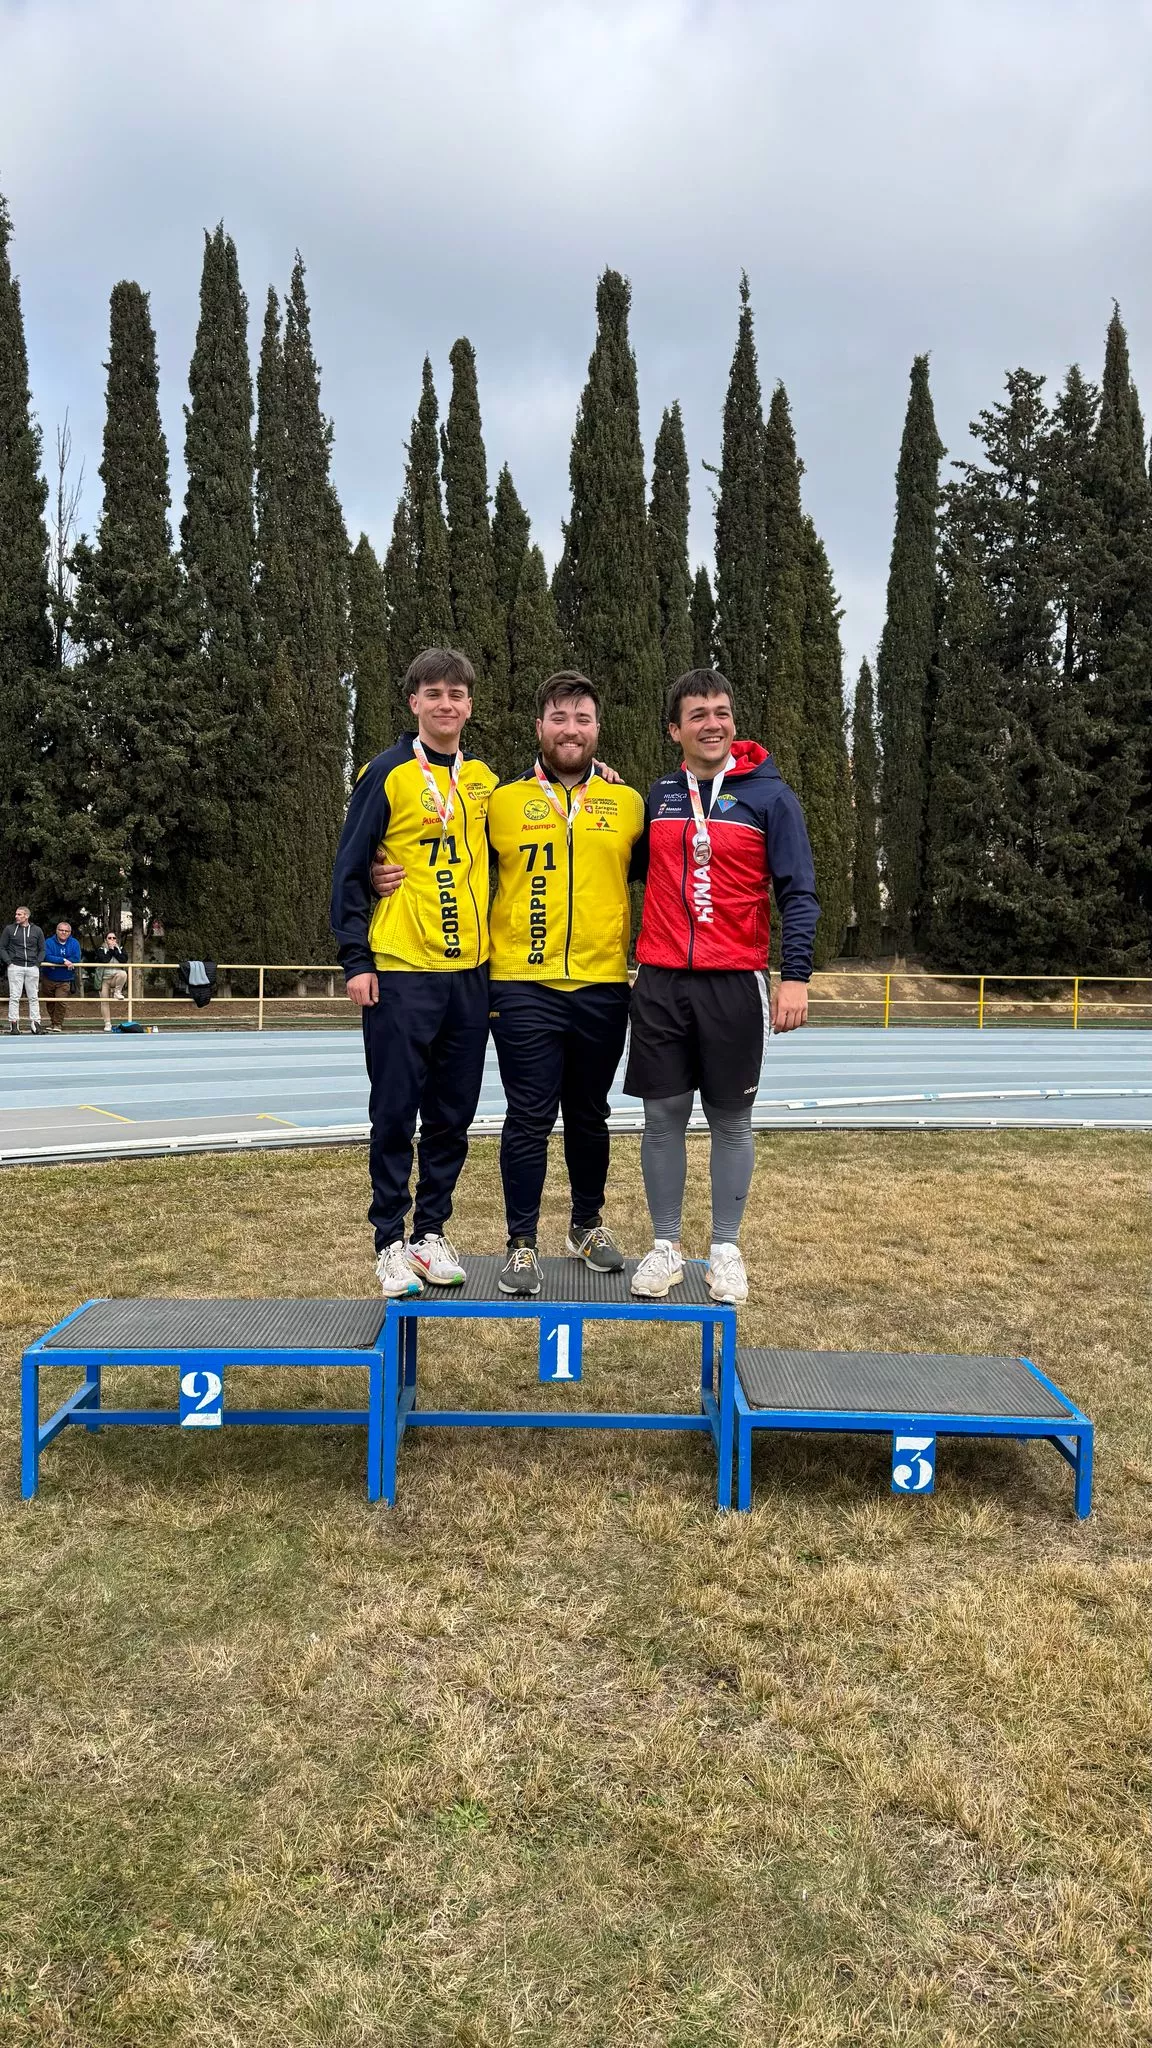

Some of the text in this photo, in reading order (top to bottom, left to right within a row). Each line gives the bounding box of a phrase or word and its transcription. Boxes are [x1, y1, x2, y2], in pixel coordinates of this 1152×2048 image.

[421, 815, 455, 826] Alcao
[521, 823, 557, 832] Alcampo
[420, 836, 461, 866] 71
[519, 842, 556, 872] 71
[435, 869, 462, 959] SCORPIO
[527, 875, 547, 965] SCORPIO
[547, 1324, 574, 1378] 1
[181, 1371, 222, 1425] 2
[893, 1436, 934, 1489] 3
